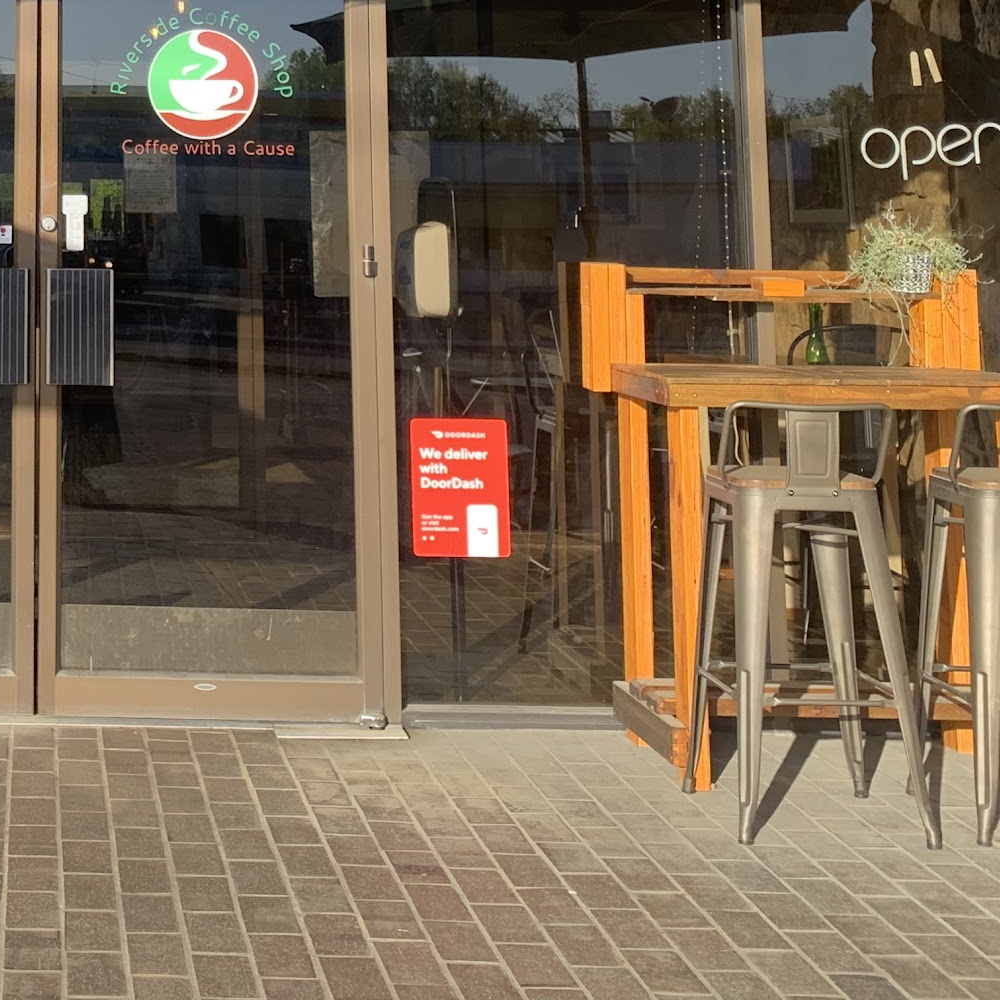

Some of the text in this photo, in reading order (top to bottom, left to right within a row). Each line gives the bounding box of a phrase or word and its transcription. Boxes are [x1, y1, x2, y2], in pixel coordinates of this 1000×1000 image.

[189, 7, 260, 43] Coffee
[262, 42, 294, 98] Shop
[121, 139, 295, 156] Coffee with a Cause
[444, 431, 486, 439] DOORDASH
[419, 447, 488, 460] We deliver
[419, 462, 448, 475] with
[420, 476, 484, 490] DoorDash
